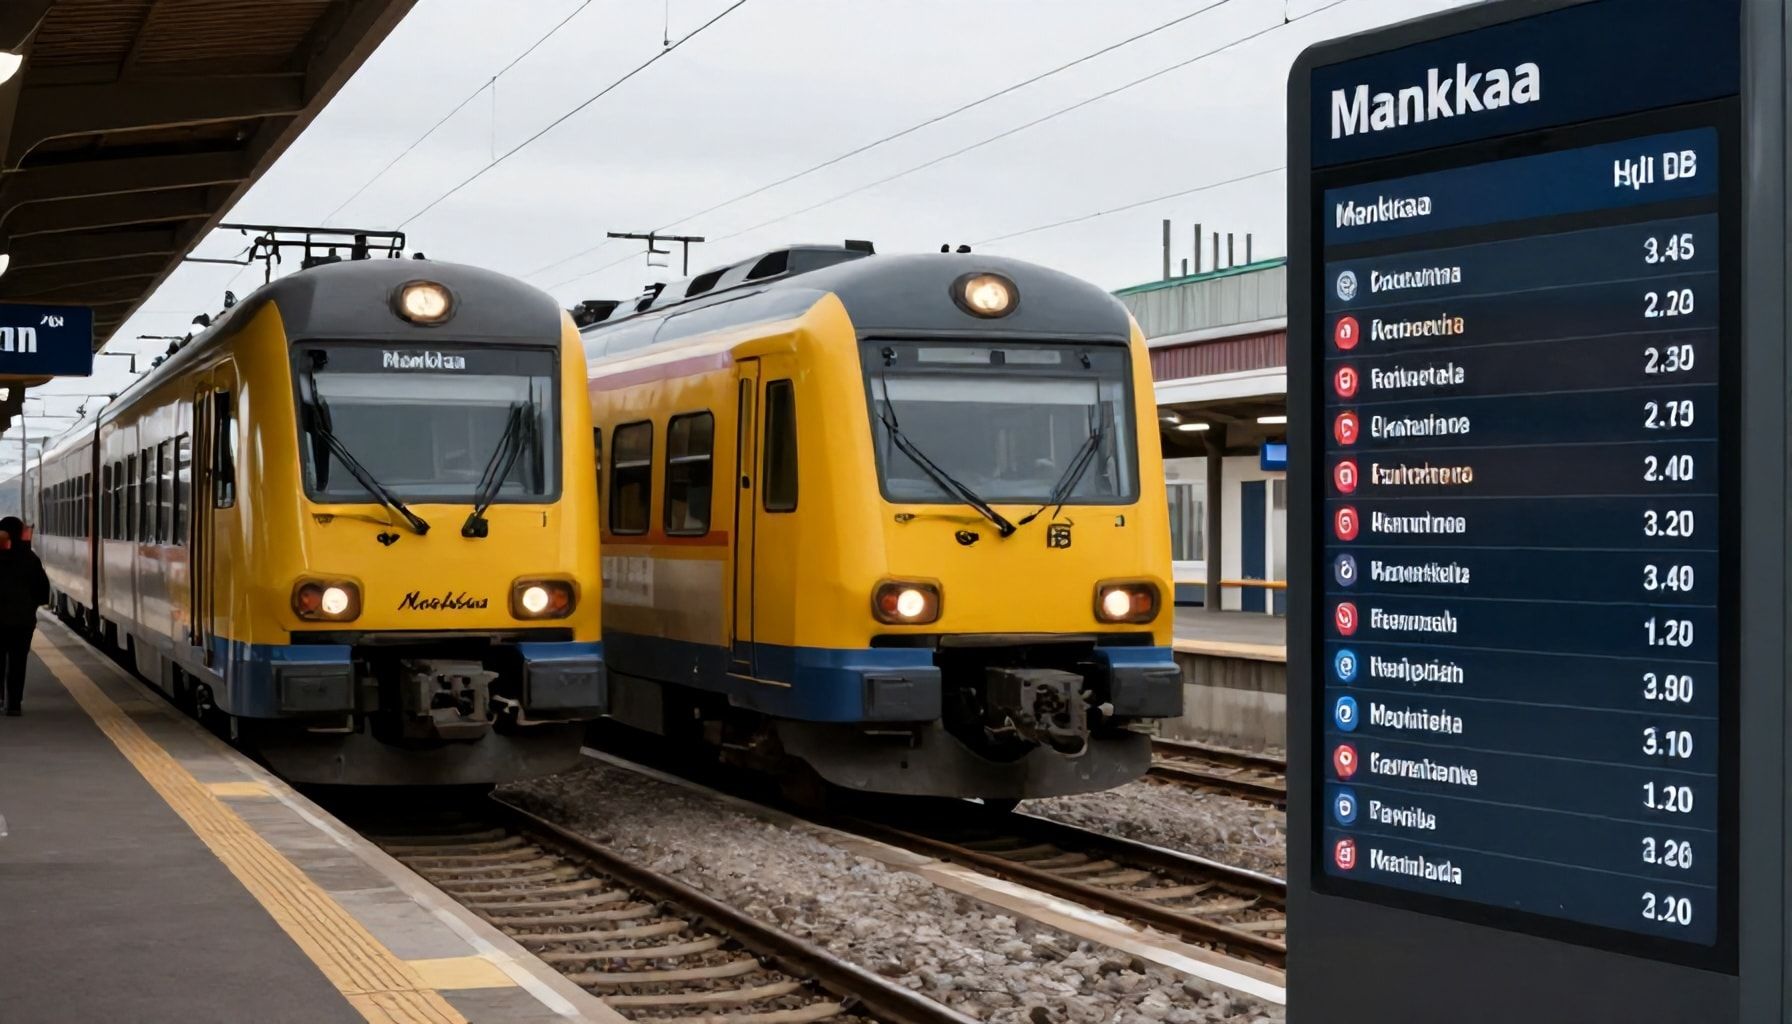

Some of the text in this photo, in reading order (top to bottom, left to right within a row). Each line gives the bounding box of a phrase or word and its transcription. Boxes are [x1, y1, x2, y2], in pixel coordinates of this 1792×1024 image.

[1331, 62, 1540, 139] Mankkaa
[1643, 454, 1694, 482] 2.40
[1644, 510, 1694, 537] 3.20
[1644, 617, 1694, 648] 1.20
[1642, 726, 1693, 759] 3.10
[1643, 781, 1694, 813] 1.20
